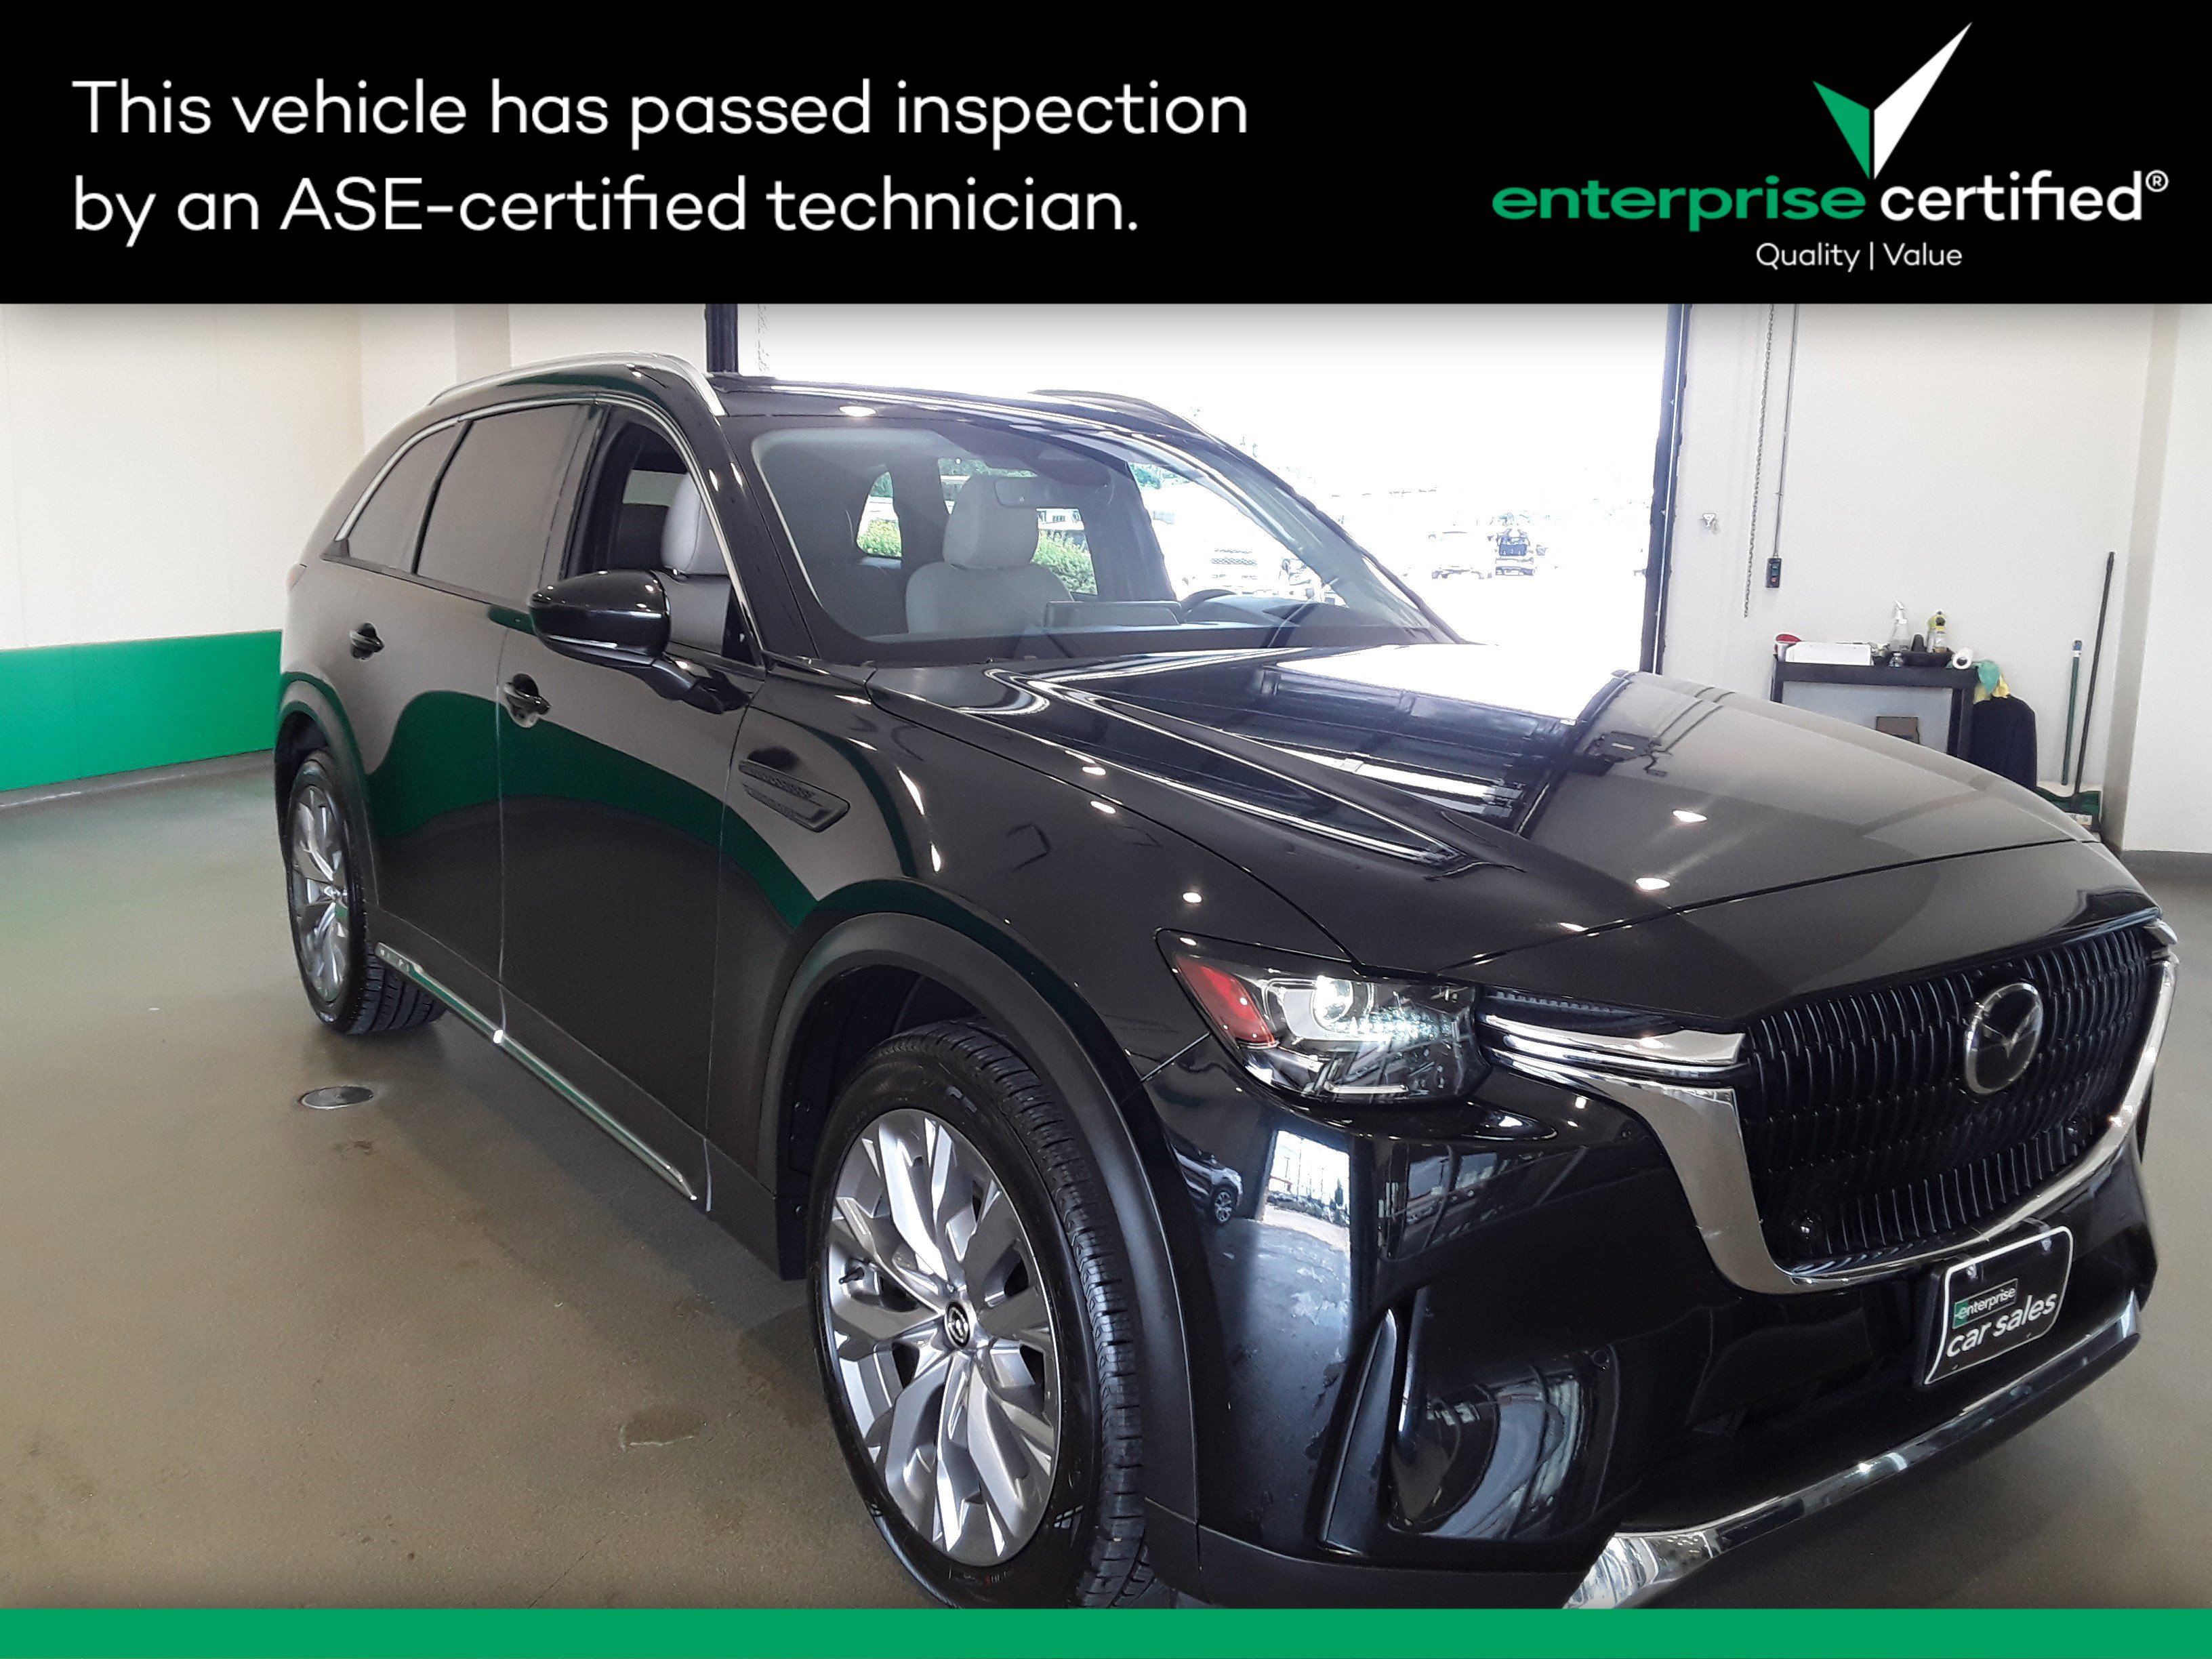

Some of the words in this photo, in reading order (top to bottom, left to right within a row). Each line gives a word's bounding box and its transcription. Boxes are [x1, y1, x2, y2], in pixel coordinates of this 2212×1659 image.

[1946, 1322, 1991, 1358] car
[1992, 1292, 2057, 1337] sales
[1954, 1286, 2016, 1320] enterprise
